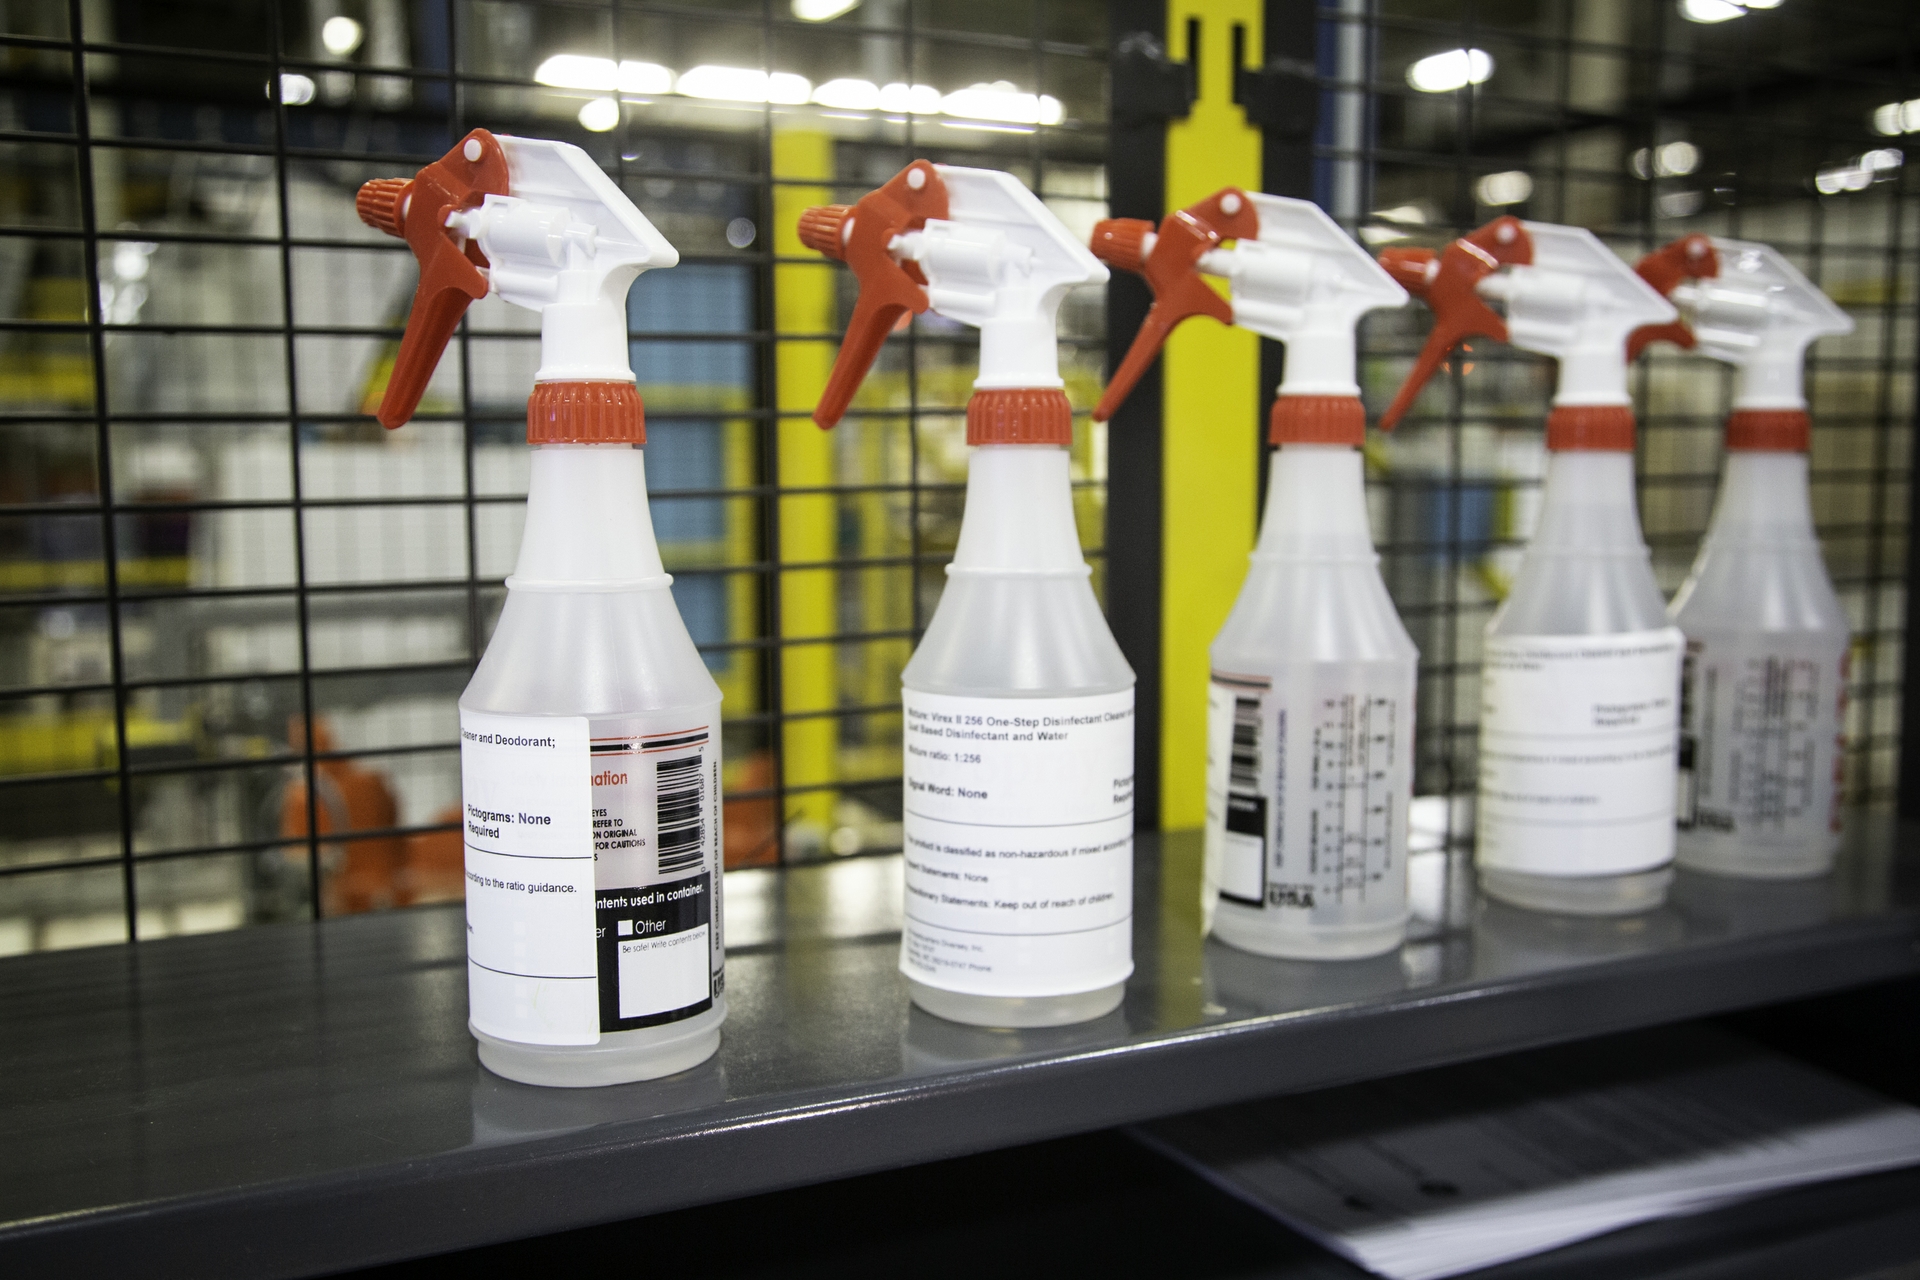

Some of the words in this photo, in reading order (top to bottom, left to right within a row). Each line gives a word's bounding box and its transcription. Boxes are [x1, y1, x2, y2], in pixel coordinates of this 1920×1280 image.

[932, 712, 952, 724] Virex
[965, 716, 983, 726] 256
[987, 717, 1040, 728] One-Step
[1043, 715, 1102, 727] Disinfectant
[479, 734, 492, 744] and
[496, 734, 556, 748] Deodorant;
[946, 728, 1008, 741] Disinfectant
[1012, 731, 1033, 741] and
[1038, 731, 1068, 741] Water
[930, 750, 951, 761] ratio:
[954, 753, 981, 764] 1:256
[928, 783, 954, 797] Word:
[958, 787, 988, 800] None
[468, 804, 515, 824] Pictograms:
[518, 813, 551, 825] None
[613, 818, 623, 827] TO
[468, 821, 500, 839] Required
[603, 829, 637, 838] ORIGINAL
[596, 842, 609, 850] FOR
[610, 838, 646, 850] CAUTIONS
[944, 846, 982, 858] classified
[985, 850, 996, 858] as
[999, 849, 1068, 859] non-hazardous
[484, 877, 491, 886] to
[492, 879, 504, 888] the
[506, 881, 525, 891] ratio
[528, 883, 577, 894] guidance.
[964, 873, 989, 884] None
[630, 893, 654, 906] used
[656, 892, 664, 903] in
[667, 883, 704, 902] container.
[941, 894, 991, 908] Statements:
[994, 900, 1019, 911] Keep
[1022, 901, 1038, 910] out
[1040, 899, 1048, 908] of
[1052, 898, 1076, 908] reach
[1078, 896, 1086, 905] of
[635, 919, 666, 935] Other
[622, 944, 631, 954] Be
[632, 942, 650, 953] safe!
[651, 938, 667, 950] Write
[668, 934, 693, 948] contents
